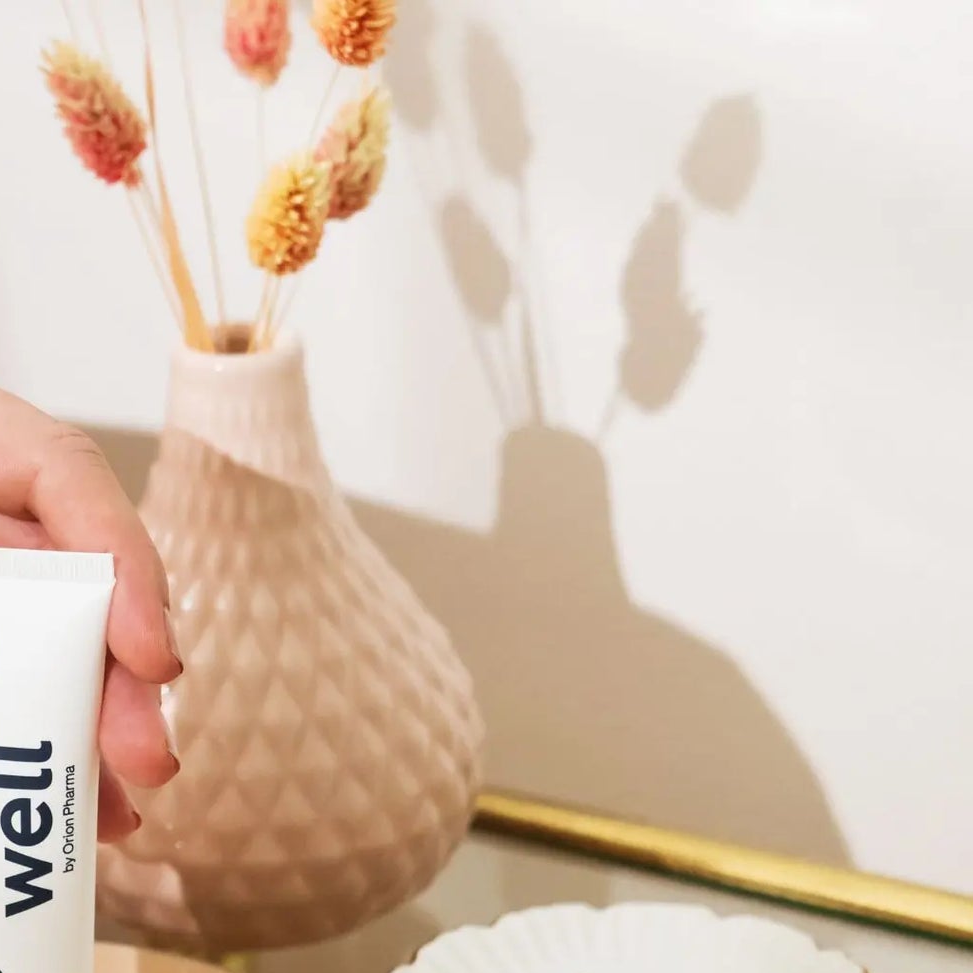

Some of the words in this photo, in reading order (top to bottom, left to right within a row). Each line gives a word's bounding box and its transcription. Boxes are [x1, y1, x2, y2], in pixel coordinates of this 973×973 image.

[62, 764, 76, 817] Pharma
[62, 818, 75, 855] Orion
[62, 857, 77, 874] by
